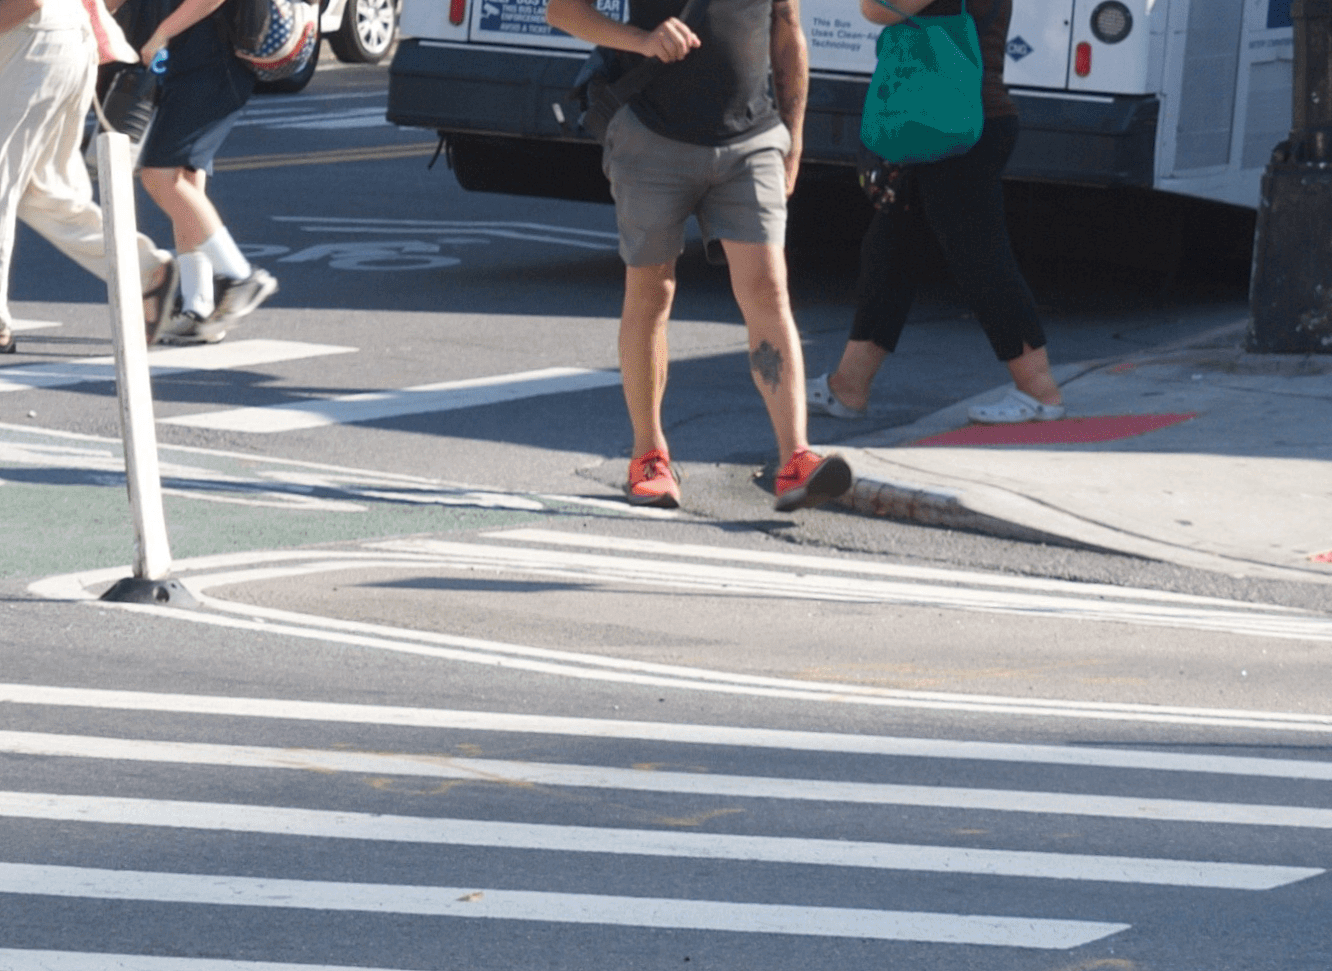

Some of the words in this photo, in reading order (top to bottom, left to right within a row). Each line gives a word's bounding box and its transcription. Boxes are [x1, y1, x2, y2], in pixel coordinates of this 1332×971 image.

[813, 17, 831, 28] This
[834, 18, 851, 28] Bus
[811, 28, 834, 38] Uses
[811, 38, 861, 52] Technology
